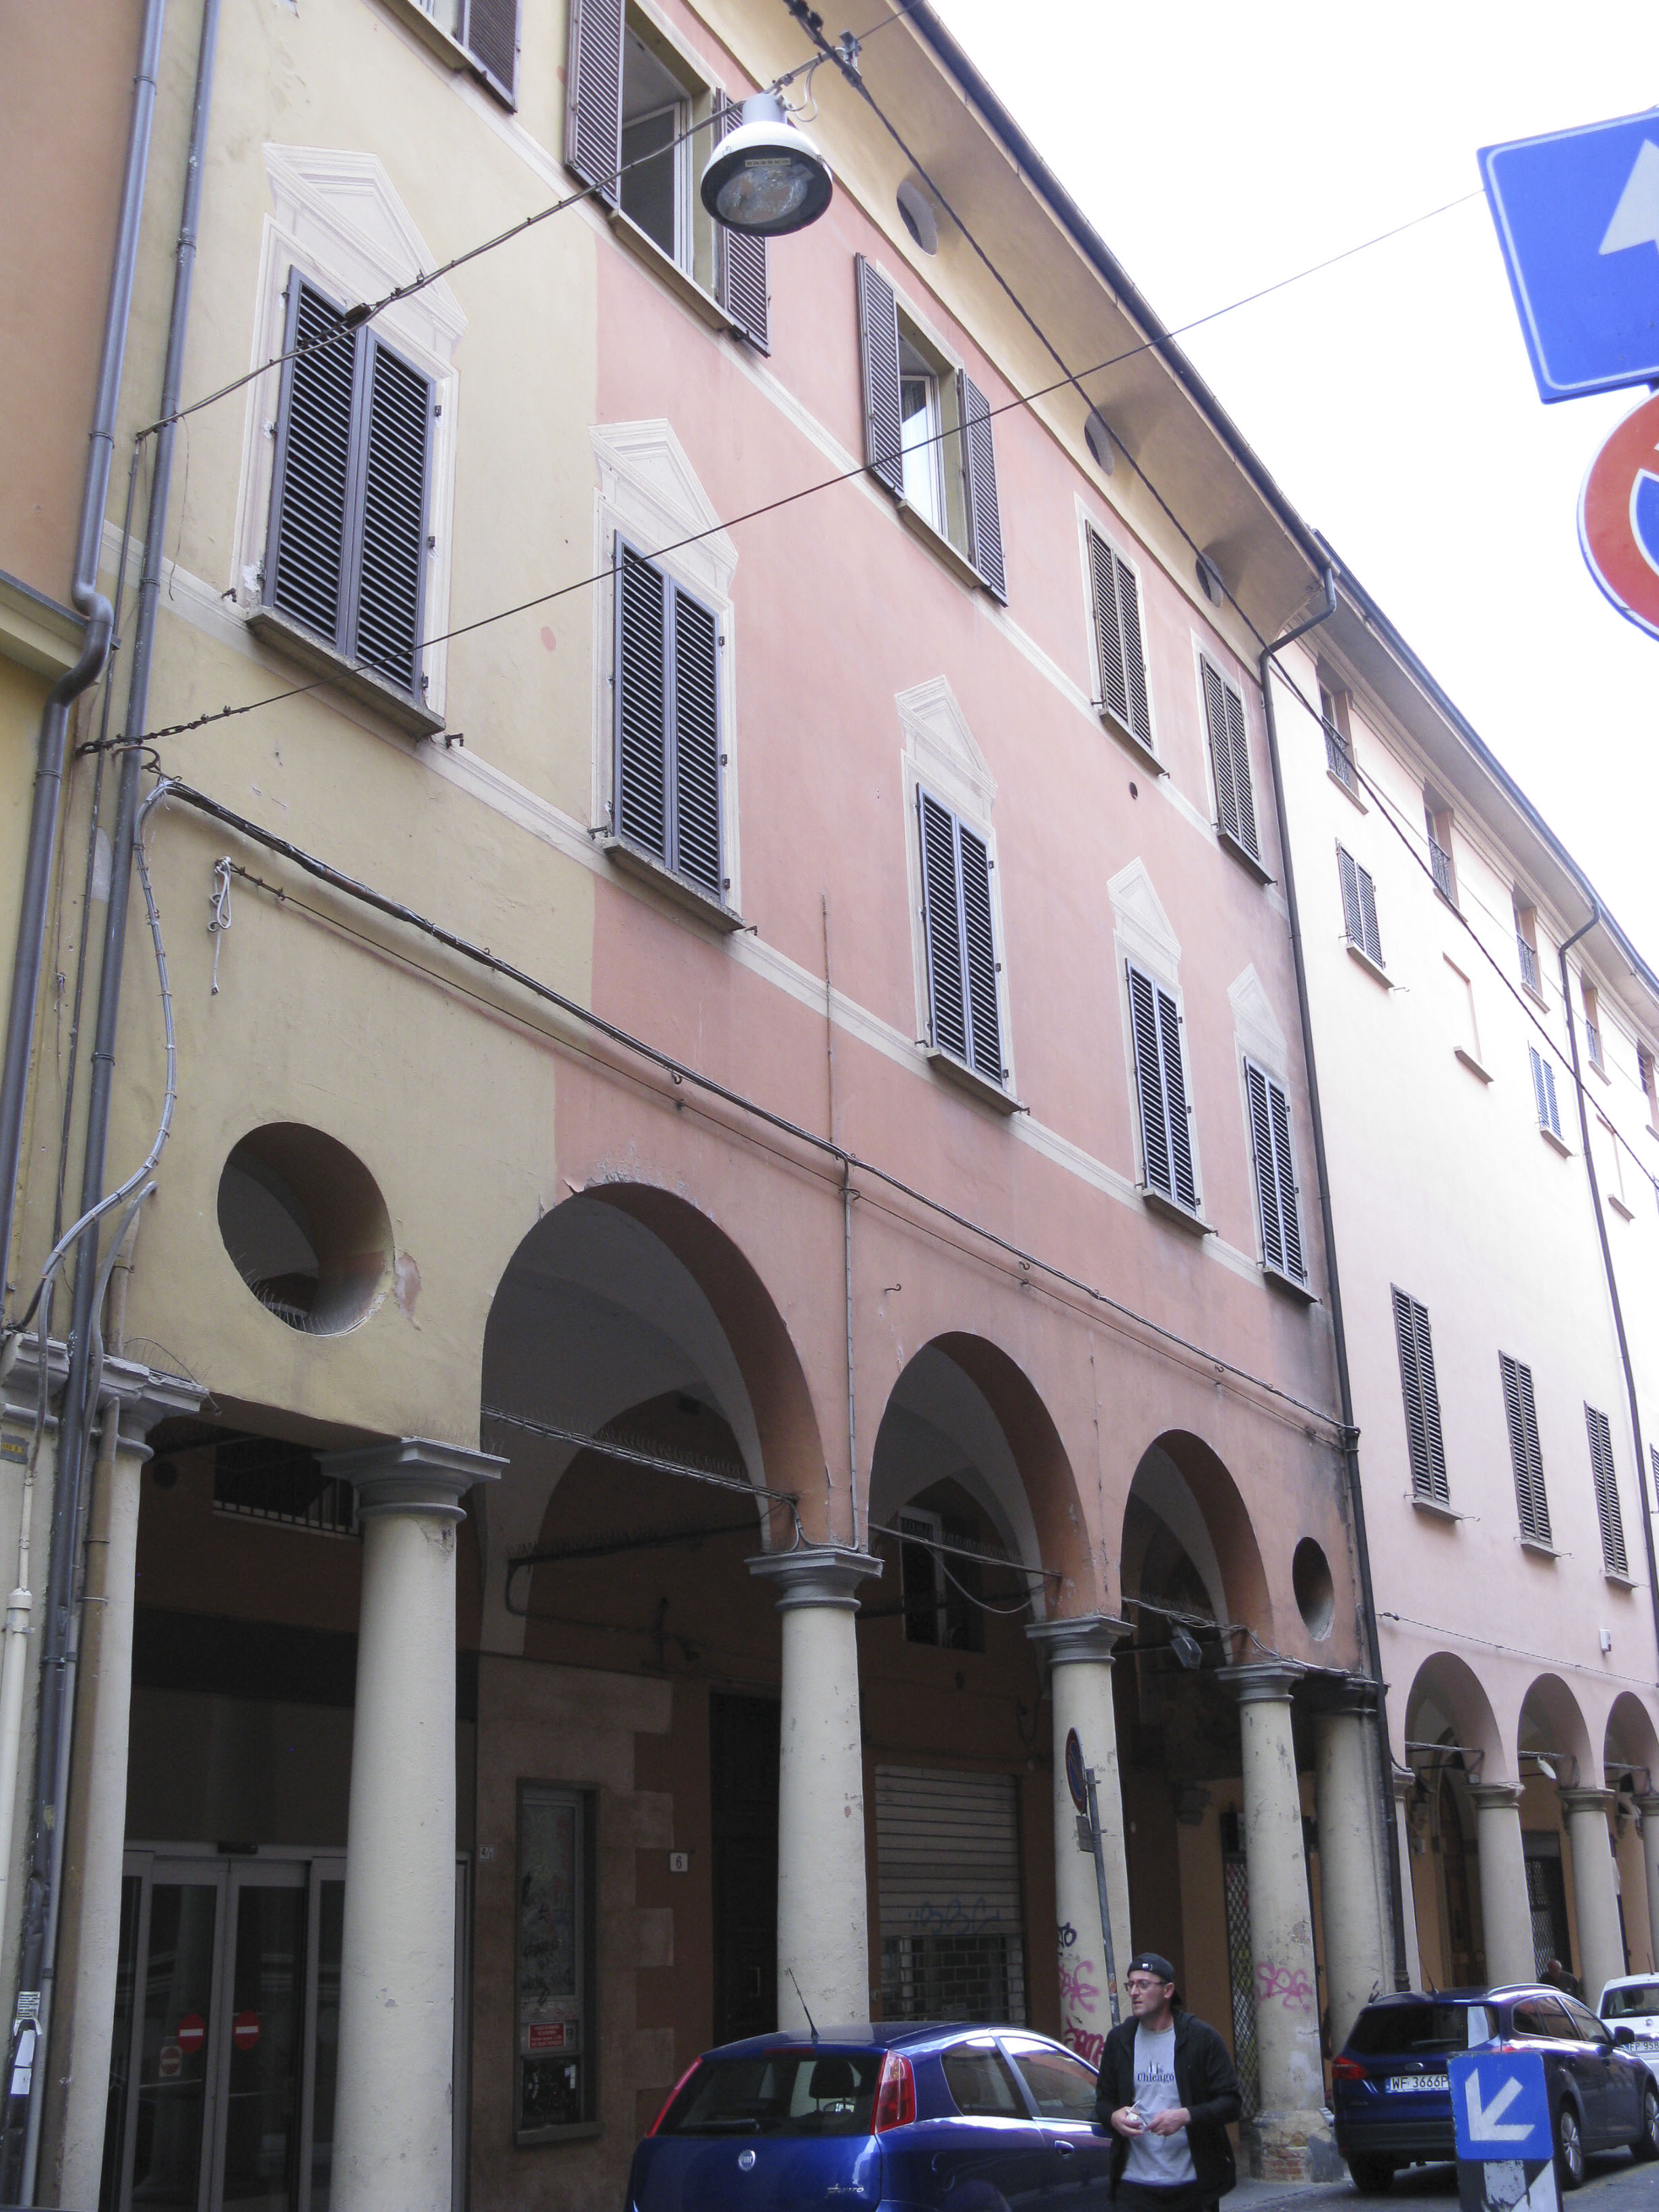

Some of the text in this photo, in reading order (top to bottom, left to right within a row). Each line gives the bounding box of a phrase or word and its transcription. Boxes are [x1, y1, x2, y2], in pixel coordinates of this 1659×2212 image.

[676, 1854, 682, 1869] 6
[1643, 2041, 1659, 2049] 958
[1137, 2072, 1174, 2083] Chicago
[1392, 2075, 1448, 2090] WF 3666P
